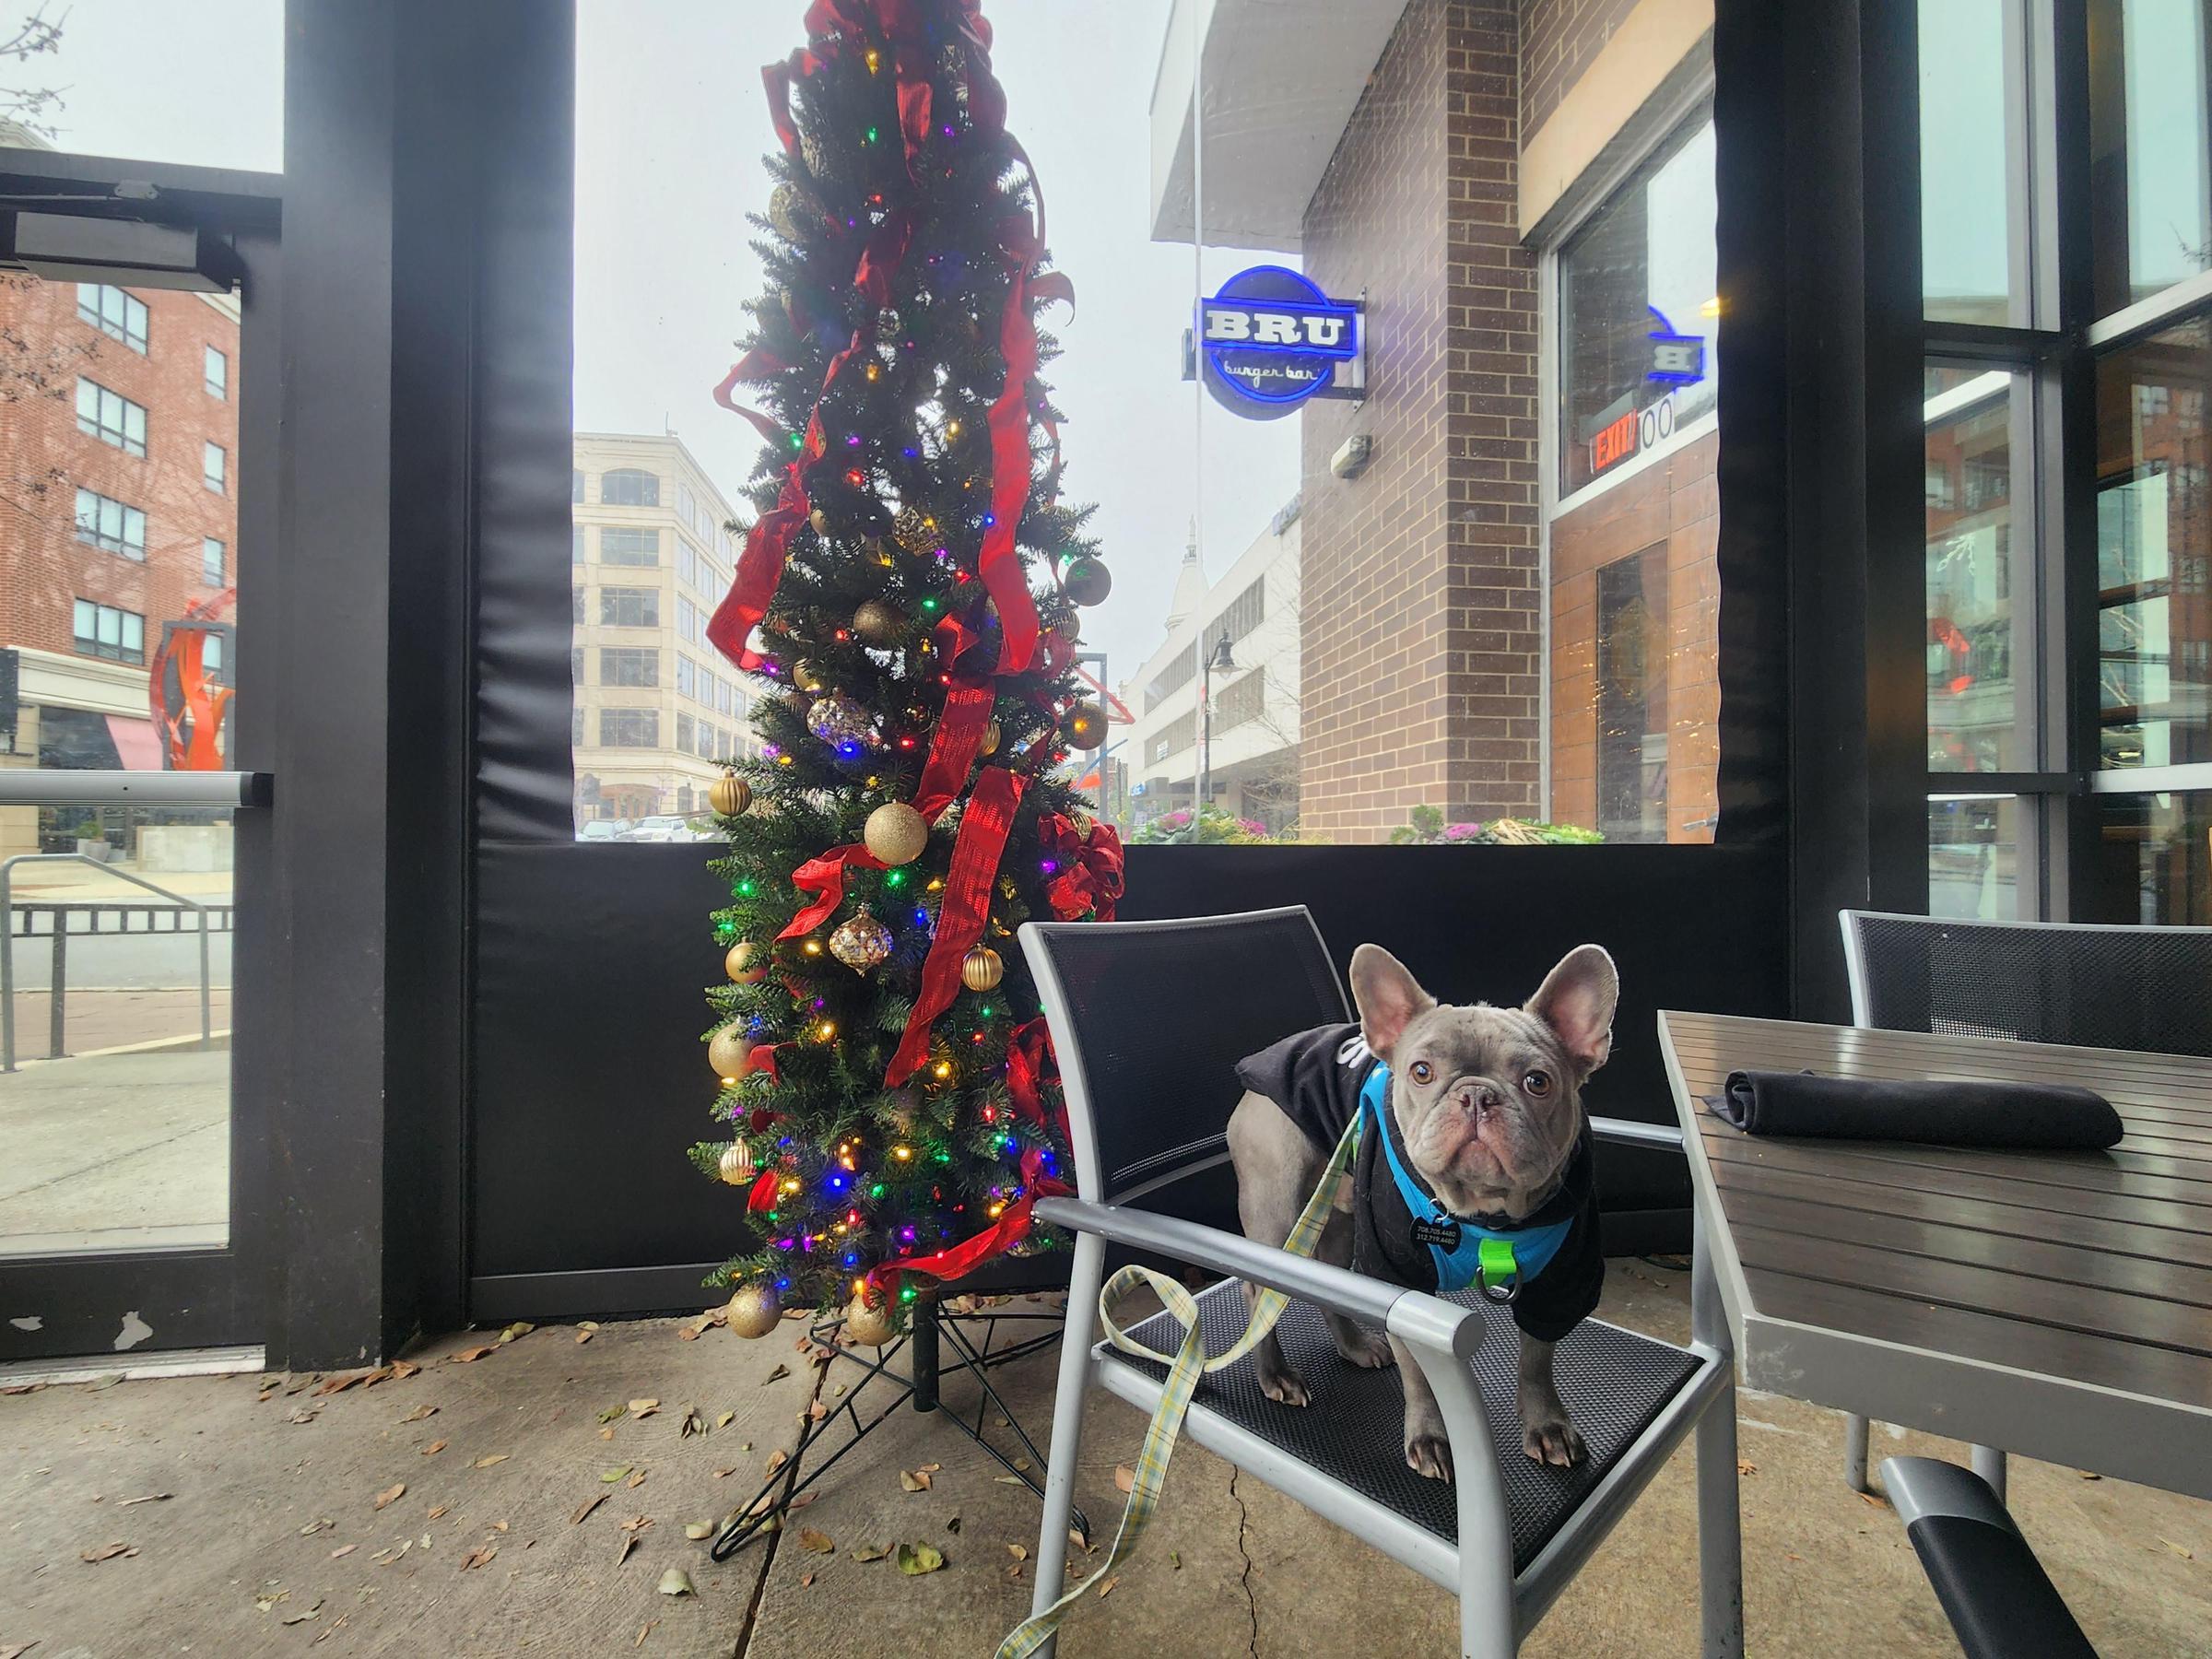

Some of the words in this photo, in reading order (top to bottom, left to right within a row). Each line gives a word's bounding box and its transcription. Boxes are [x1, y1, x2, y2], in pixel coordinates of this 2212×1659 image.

[1206, 310, 1345, 346] BRU
[1224, 360, 1285, 388] burger
[1285, 365, 1319, 381] bar
[1595, 412, 1631, 471] EXIT
